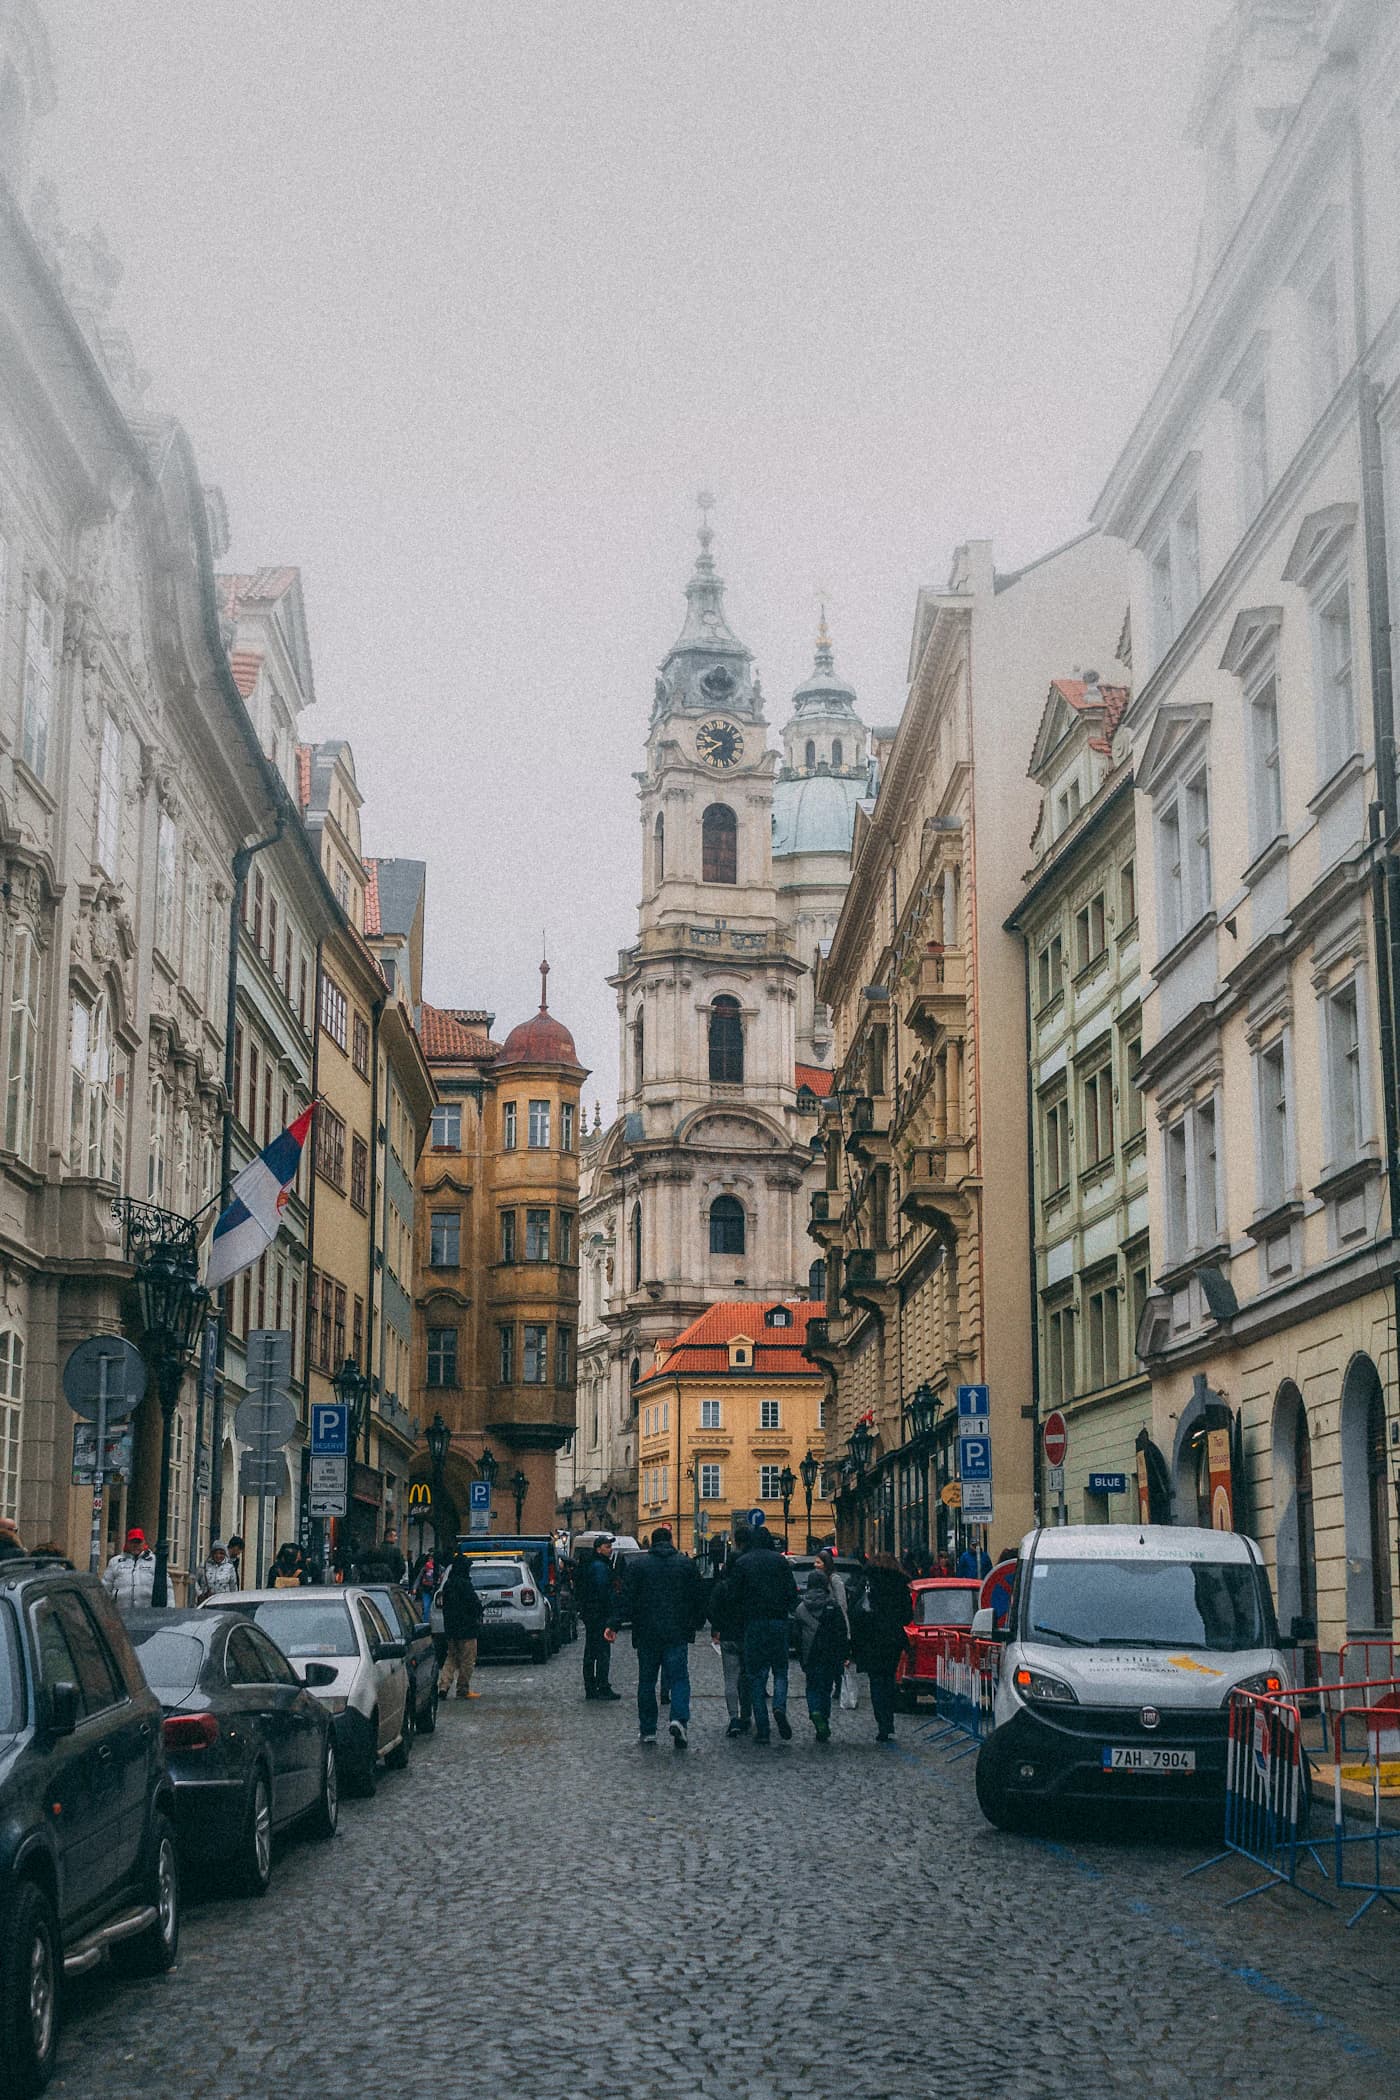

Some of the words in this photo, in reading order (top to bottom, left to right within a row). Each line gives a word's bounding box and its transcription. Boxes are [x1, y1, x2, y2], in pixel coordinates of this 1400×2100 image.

[319, 1410, 340, 1440] P
[966, 1442, 984, 1468] P
[1094, 1477, 1121, 1487] BLUE
[474, 1485, 487, 1502] P
[1157, 1551, 1206, 1559] ONLINE
[1143, 1712, 1157, 1722] FIAT
[1114, 1750, 1142, 1766] 7AH
[1152, 1751, 1189, 1767] 7904
